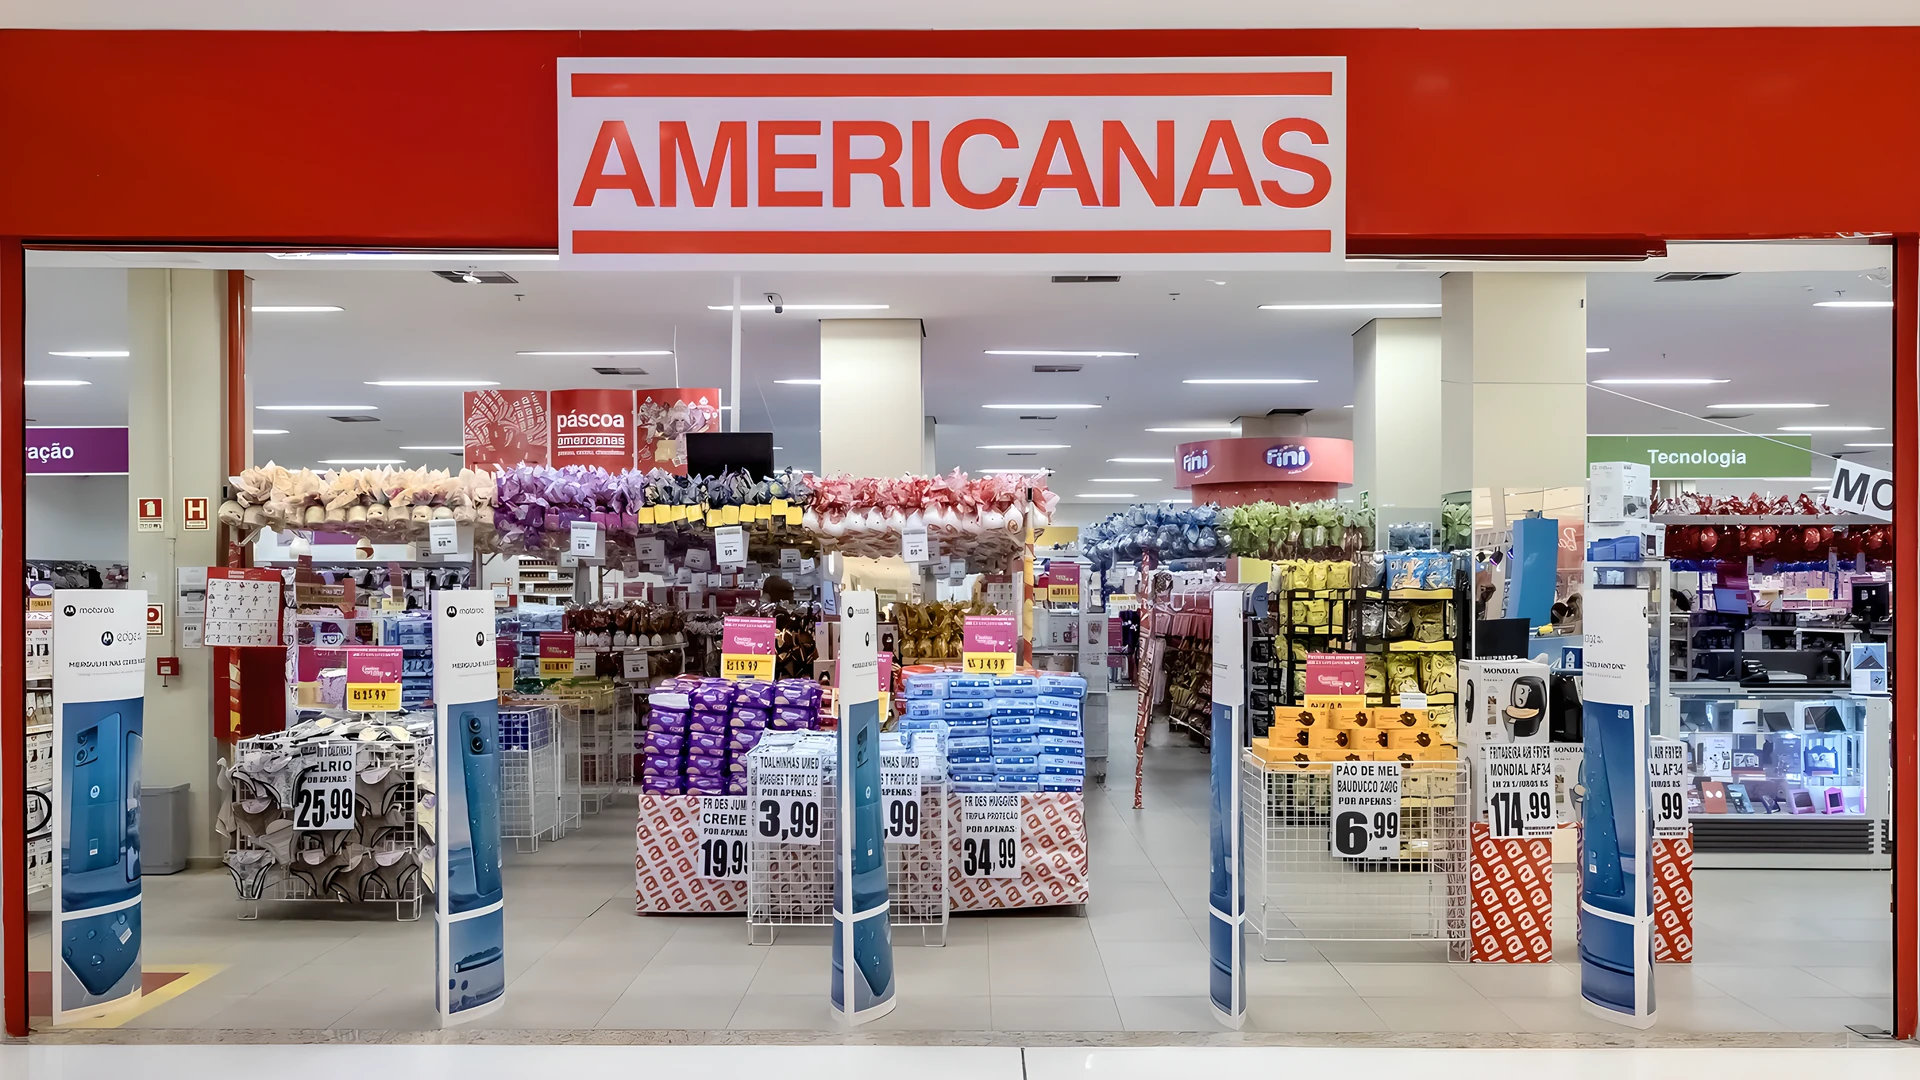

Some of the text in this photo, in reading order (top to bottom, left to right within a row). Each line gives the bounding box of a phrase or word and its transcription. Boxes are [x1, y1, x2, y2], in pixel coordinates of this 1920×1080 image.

[573, 117, 1333, 210] AMERICANAS
[557, 409, 625, 432] páscoa
[557, 436, 625, 446] americanas
[26, 442, 75, 464] ação
[1183, 449, 1208, 472] Fini
[1266, 445, 1306, 467] Fini
[1647, 449, 1747, 468] Tecnologia
[1336, 763, 1399, 777] PÃO DE MEL
[1490, 763, 1552, 777] MONDIAL AF34
[1662, 763, 1684, 777] AF34
[296, 787, 353, 828] 25,99
[1490, 791, 1552, 837] 174,99
[759, 799, 819, 841] 3,99
[1335, 811, 1398, 856] 6,99
[963, 837, 1016, 877] 34,99
